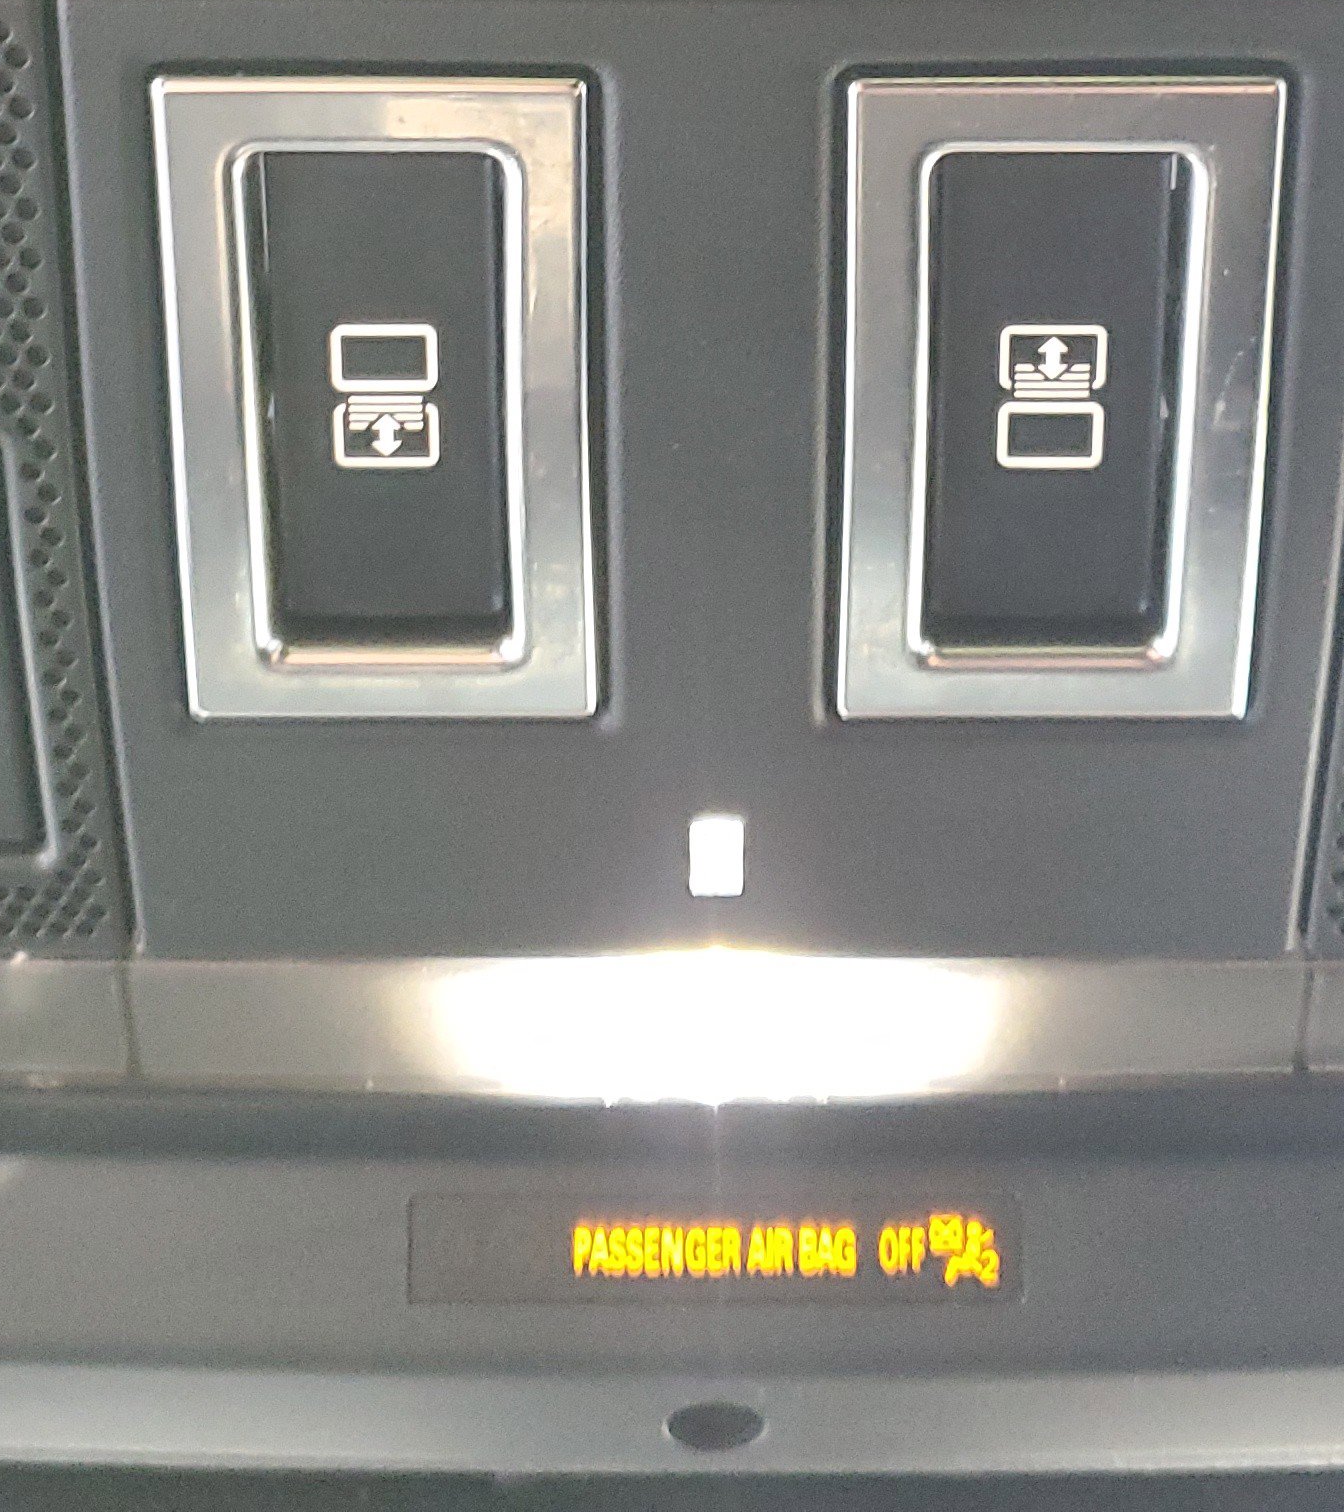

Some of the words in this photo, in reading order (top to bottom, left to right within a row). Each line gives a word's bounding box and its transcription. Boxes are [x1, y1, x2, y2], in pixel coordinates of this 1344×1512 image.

[572, 1224, 742, 1276] PASSENGER
[747, 1224, 794, 1276] AIR
[798, 1224, 857, 1276] BAG
[877, 1225, 926, 1275] OFF
